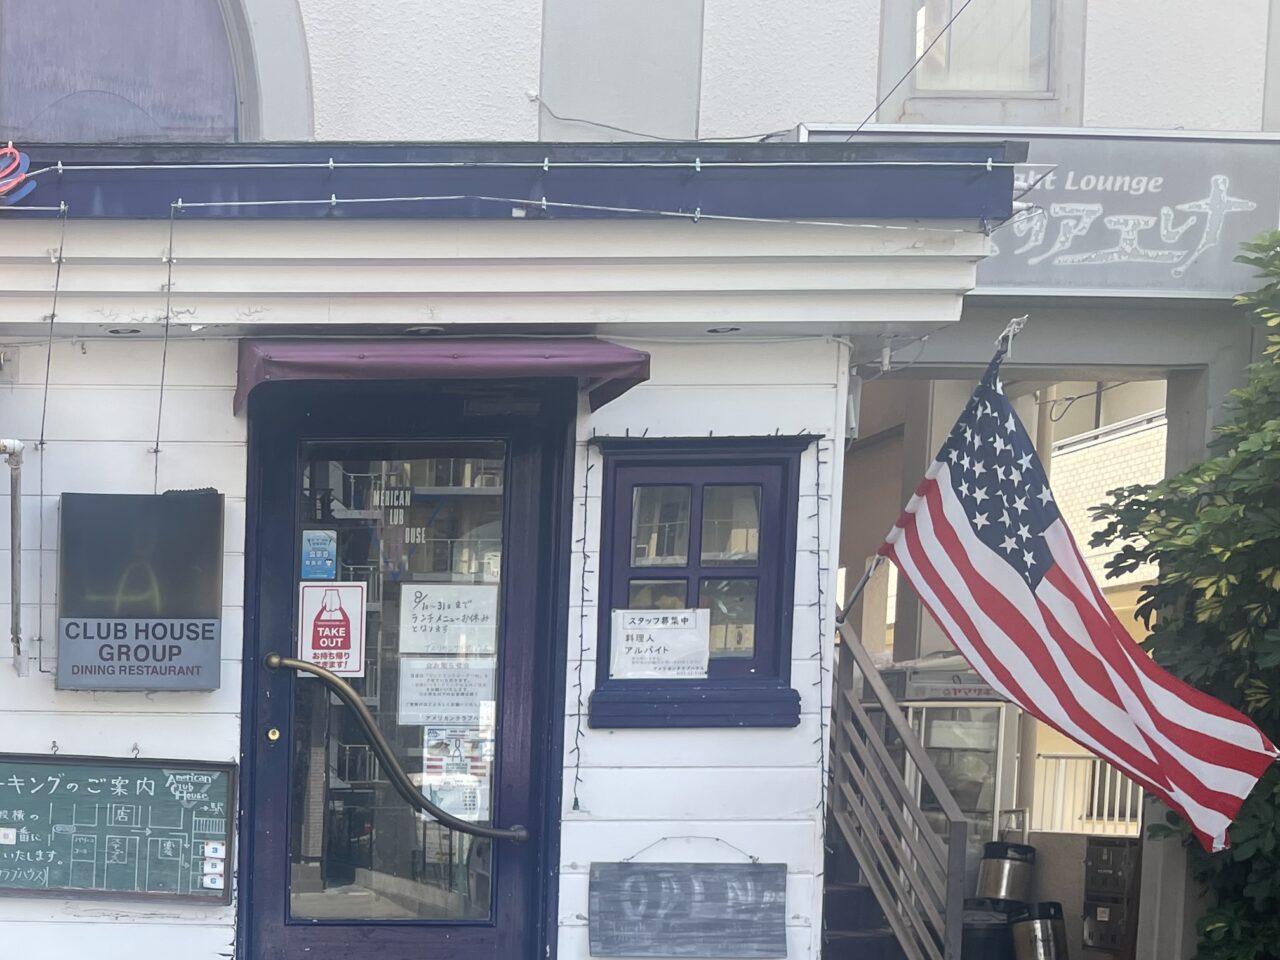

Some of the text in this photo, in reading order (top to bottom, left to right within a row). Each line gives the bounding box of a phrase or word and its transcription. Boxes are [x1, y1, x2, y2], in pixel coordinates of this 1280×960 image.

[1065, 171, 1163, 195] Lounge
[990, 175, 1257, 277] リアエレナ
[628, 616, 689, 625] スタッフ募集中
[65, 622, 215, 641] CLUB HOUSE
[317, 627, 346, 637] TAKE
[411, 625, 449, 634] となります
[319, 638, 344, 647] OUT
[625, 633, 655, 643] 料理人
[98, 643, 182, 662] GROUP
[312, 652, 350, 660] お持ち帰り
[624, 646, 669, 655] アルバイト
[72, 664, 202, 676] DINING RESTAURANT
[165, 773, 212, 787] American
[116, 806, 132, 822] 店
